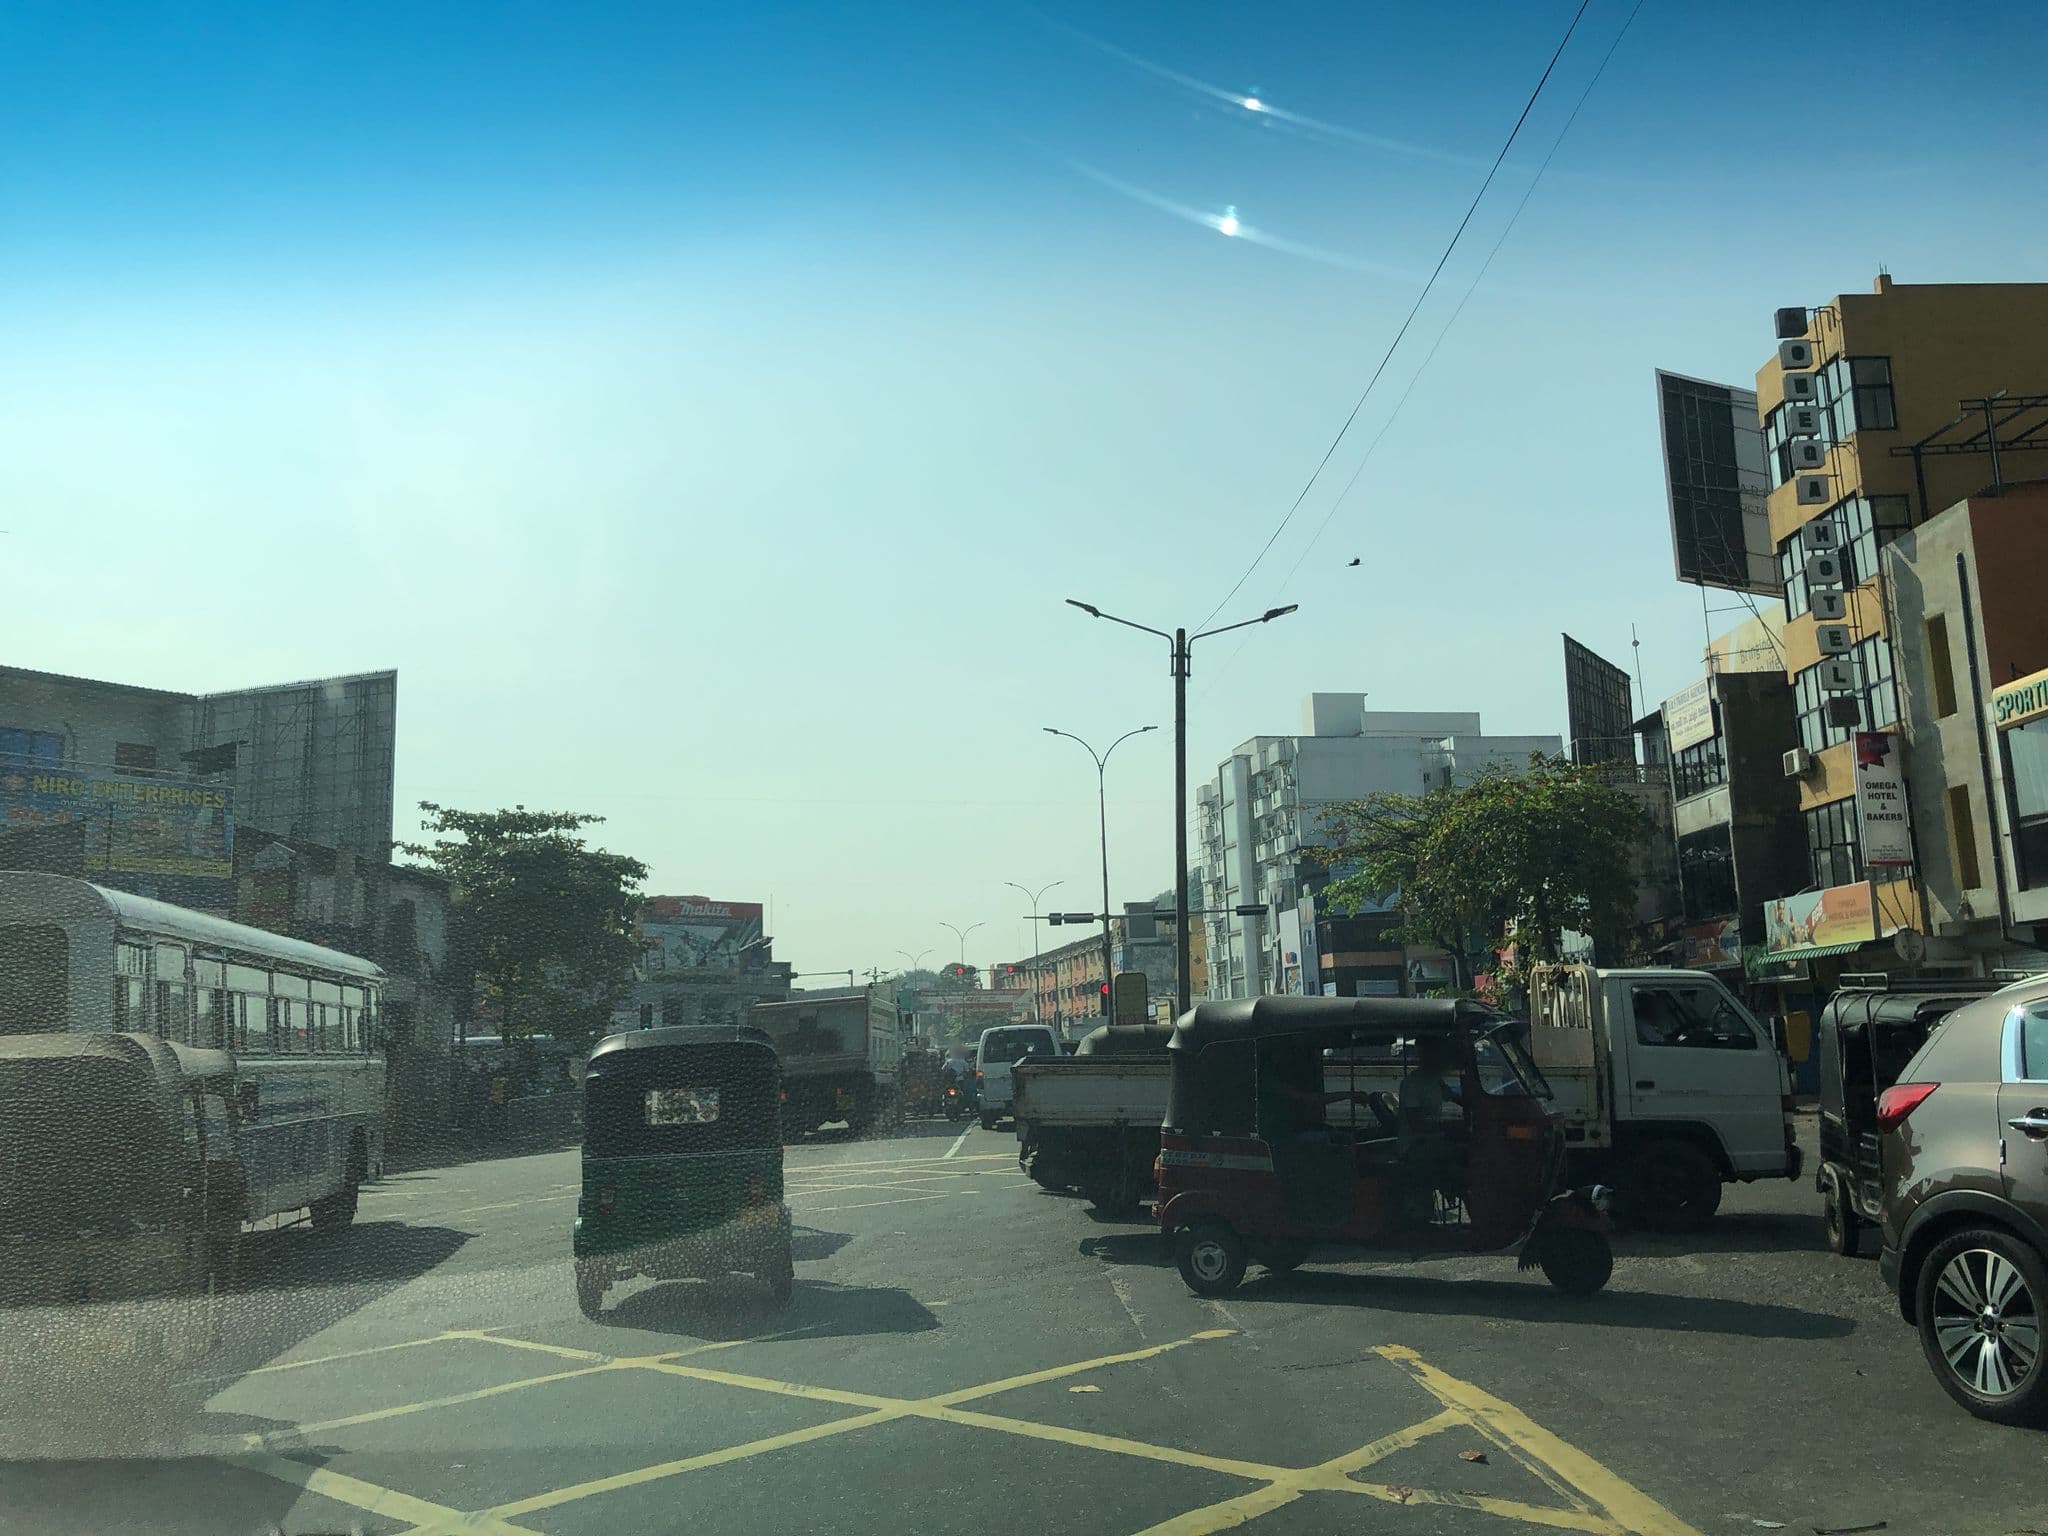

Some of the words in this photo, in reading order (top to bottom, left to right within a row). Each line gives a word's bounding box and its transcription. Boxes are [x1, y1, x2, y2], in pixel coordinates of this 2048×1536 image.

[1815, 526, 1847, 683] HOTEL
[1996, 680, 2048, 722] SPORTI
[32, 775, 85, 796] NIRO
[92, 781, 225, 809] ENTERPRISES
[1865, 781, 1898, 790] OMEGA
[1868, 792, 1898, 801] HOTEL
[1866, 812, 1903, 821] BAKERS
[680, 901, 731, 917] Makita
